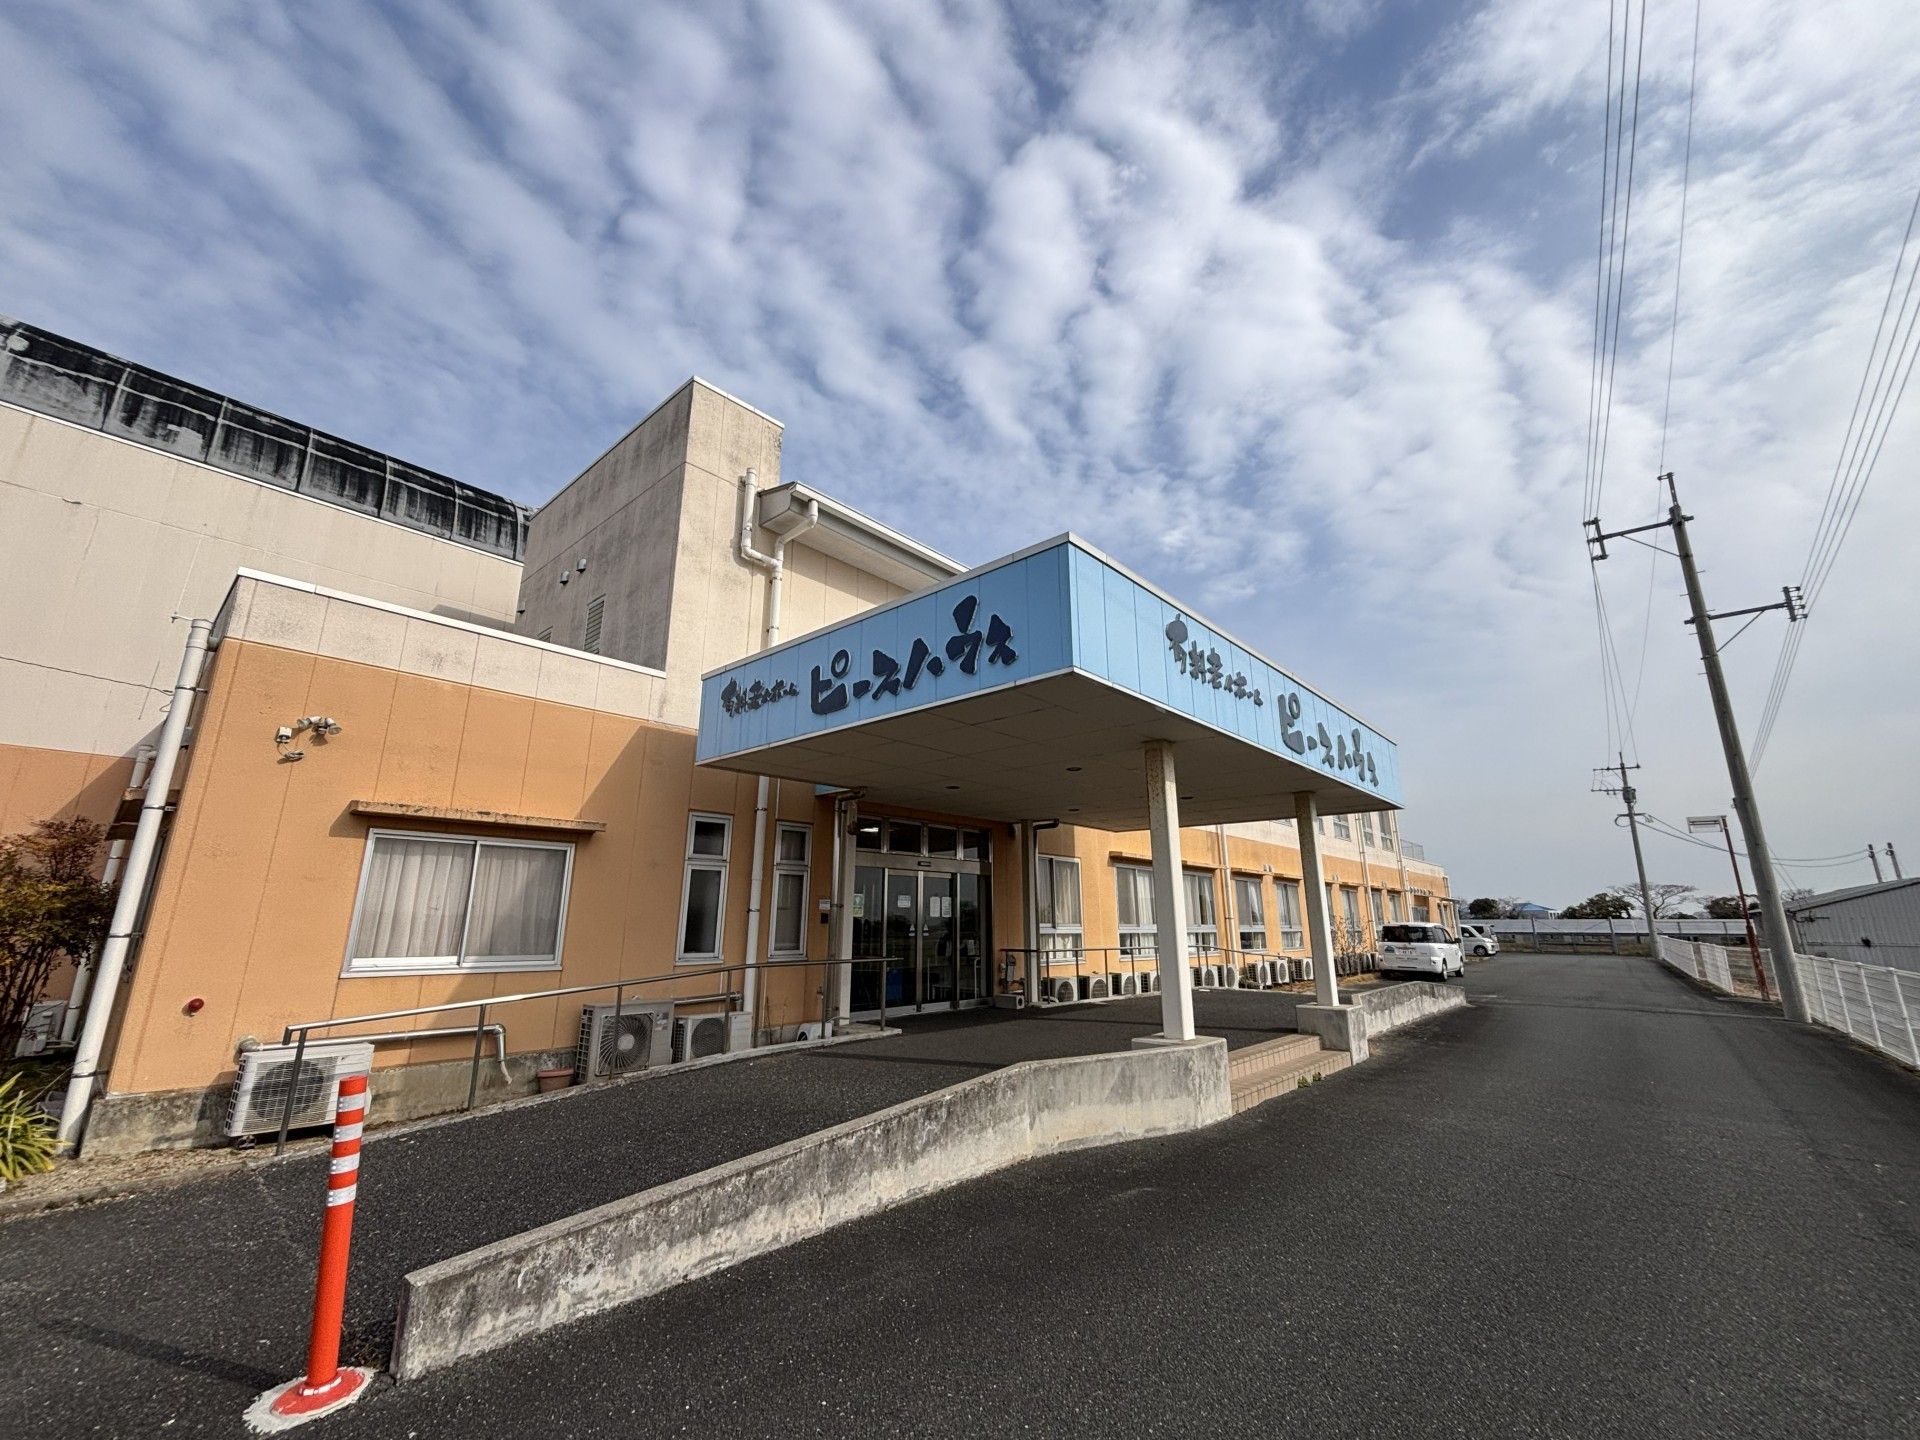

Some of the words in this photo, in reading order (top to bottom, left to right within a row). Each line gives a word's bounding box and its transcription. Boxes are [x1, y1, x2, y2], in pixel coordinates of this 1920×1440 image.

[810, 594, 1019, 715] ピースハウス
[1277, 692, 1379, 787] ピースハウス
